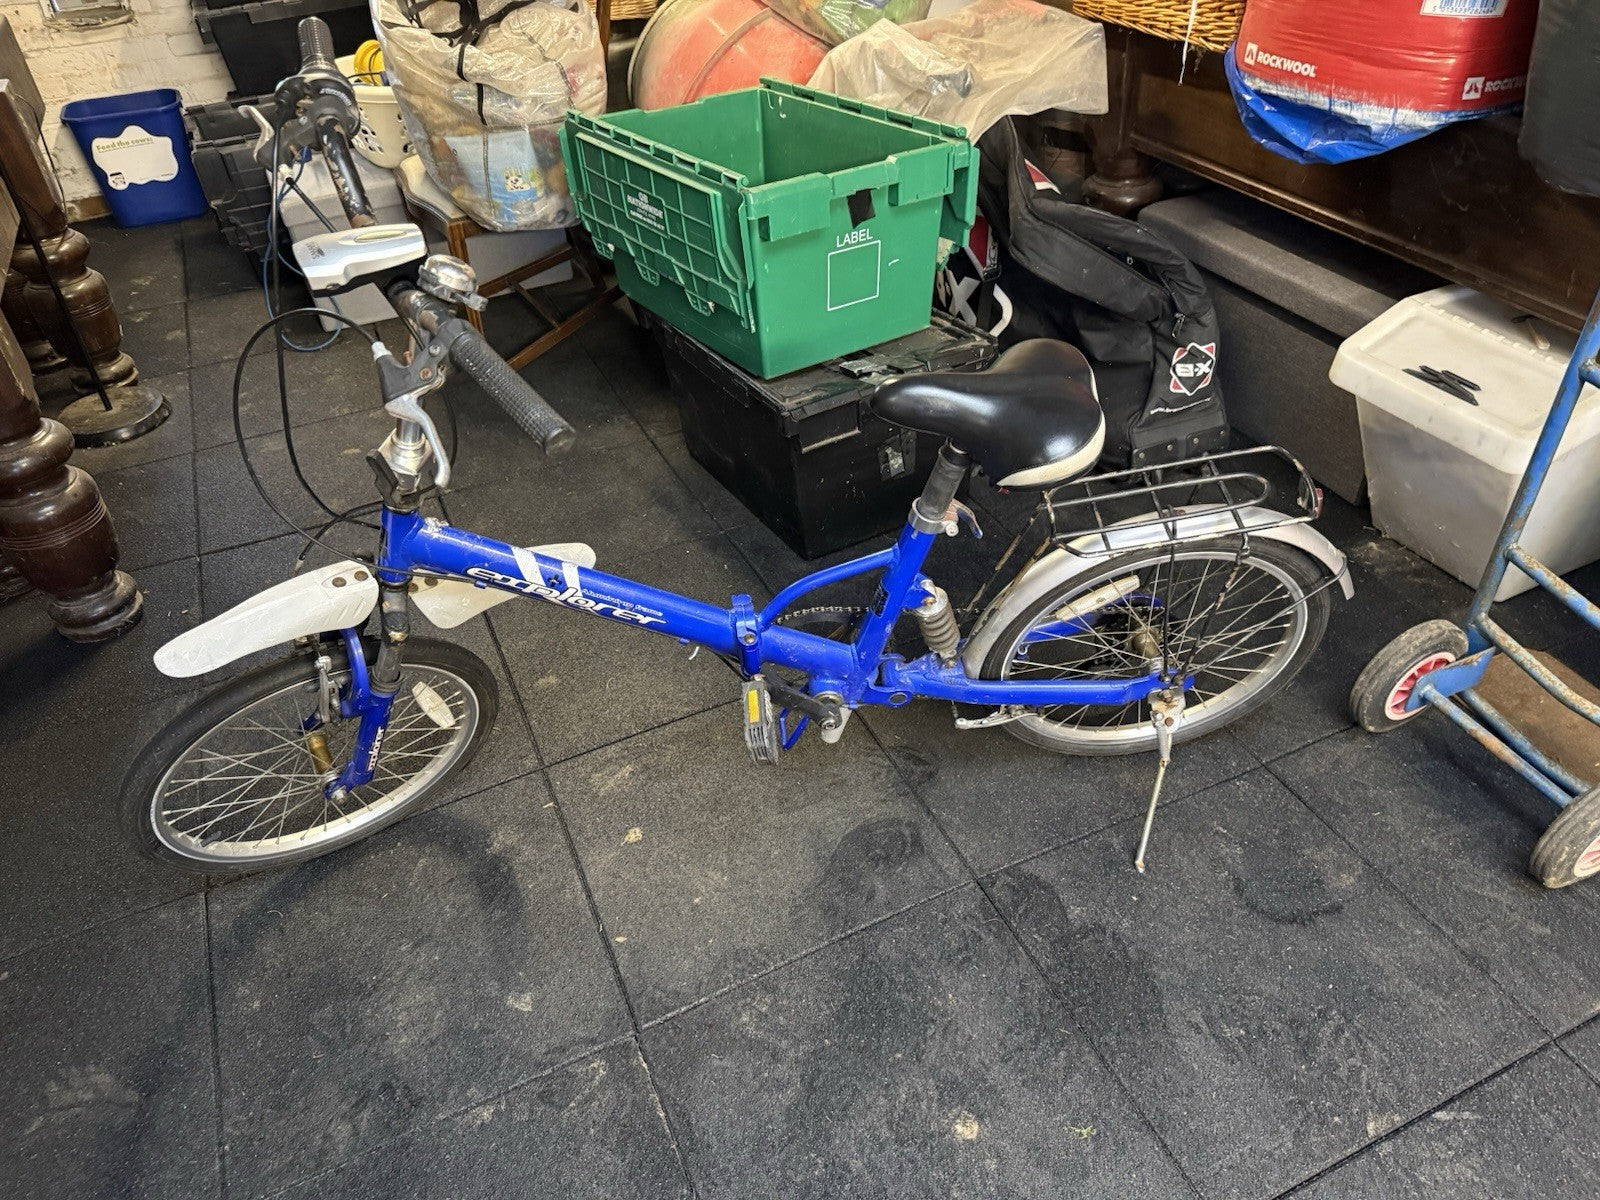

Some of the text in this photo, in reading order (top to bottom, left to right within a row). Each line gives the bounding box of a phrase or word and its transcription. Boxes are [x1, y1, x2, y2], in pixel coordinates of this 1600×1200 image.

[1257, 51, 1317, 78] ROCKWOOL
[117, 139, 130, 147] the
[836, 228, 873, 248] LABEL
[467, 567, 668, 625] explorer
[368, 726, 385, 771] explorer
